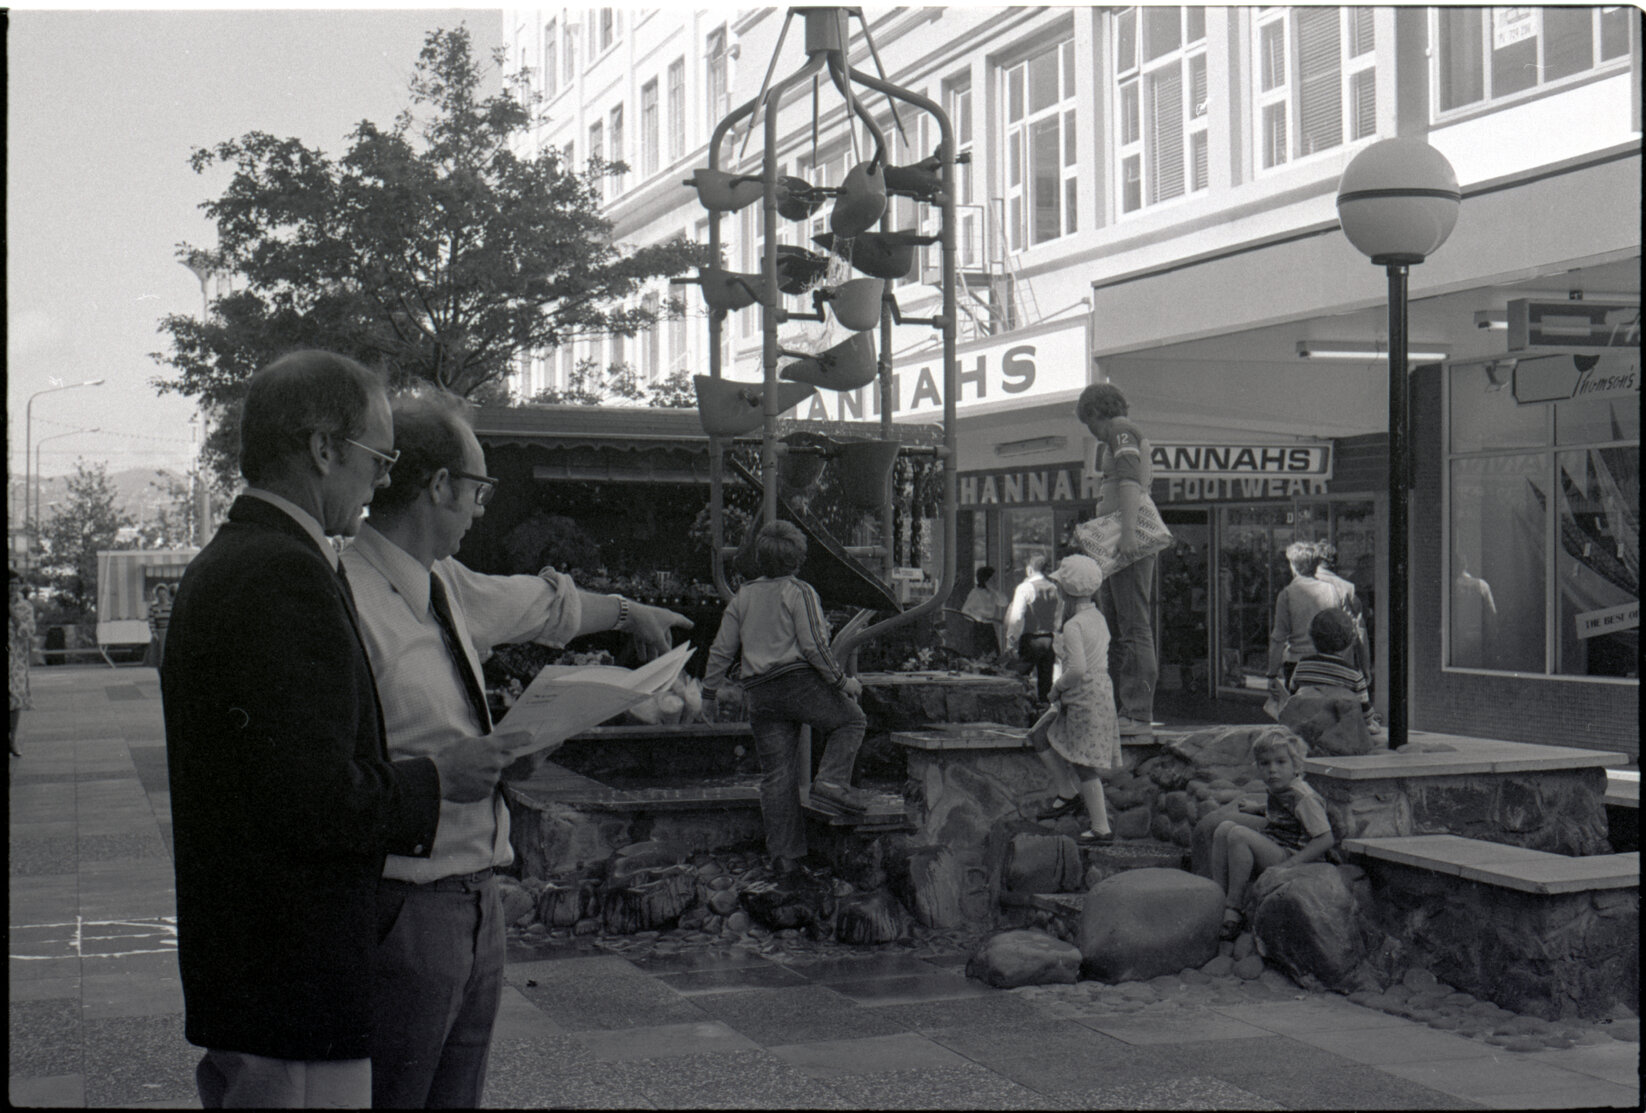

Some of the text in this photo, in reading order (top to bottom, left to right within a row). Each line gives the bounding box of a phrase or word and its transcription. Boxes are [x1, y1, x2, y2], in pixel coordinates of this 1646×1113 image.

[783, 345, 1037, 420] ANNAHS
[1116, 432, 1129, 446] 12
[1151, 447, 1311, 471] ANNAHS
[960, 469, 1329, 505] HANNAH FOOTWEAR
